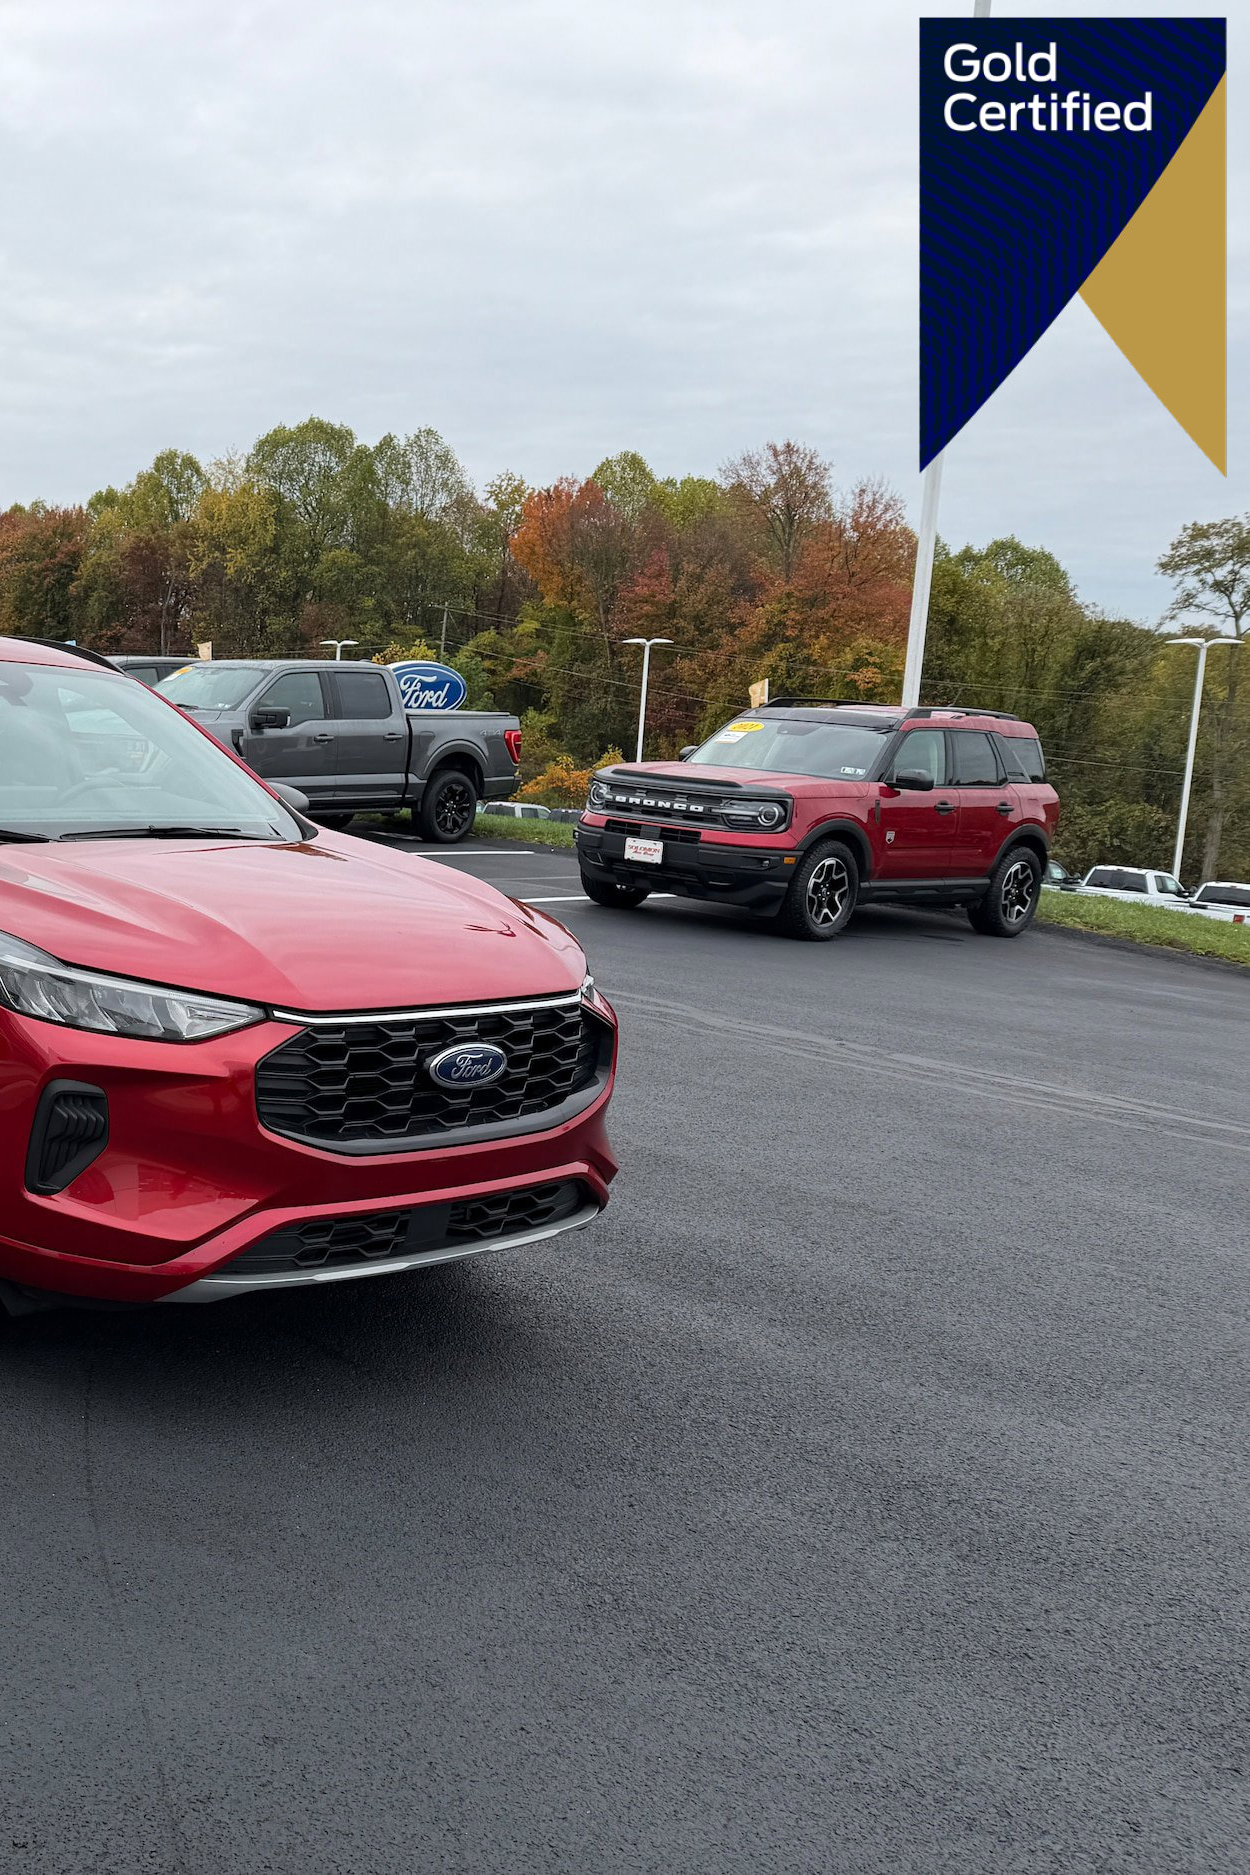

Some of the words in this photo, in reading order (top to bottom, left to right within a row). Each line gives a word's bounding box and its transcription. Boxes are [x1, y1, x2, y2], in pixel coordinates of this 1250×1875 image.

[399, 674, 450, 708] Ford
[615, 795, 704, 813] BRONCO
[627, 844, 661, 854] SOLOMON
[451, 1054, 493, 1079] Ford
